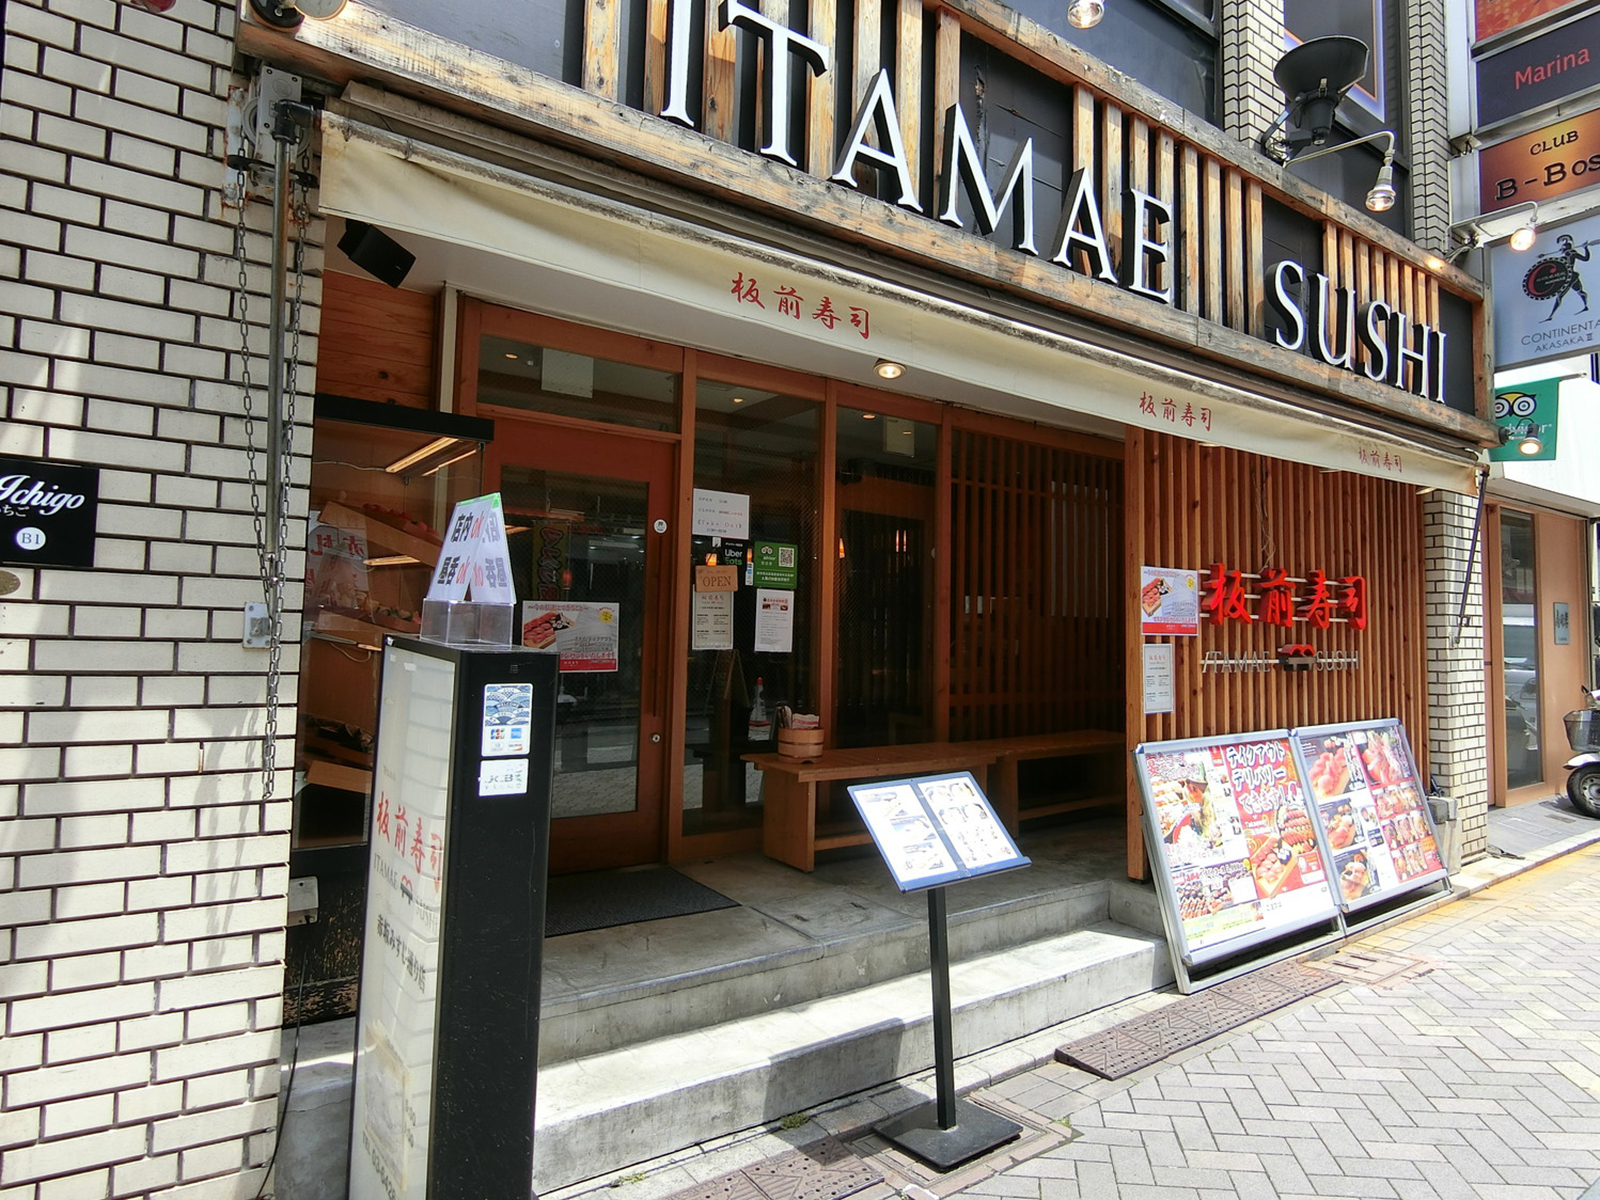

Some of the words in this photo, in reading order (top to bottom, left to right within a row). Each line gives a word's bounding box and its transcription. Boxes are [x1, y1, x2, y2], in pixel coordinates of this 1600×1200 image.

[1514, 48, 1590, 89] Marina
[1530, 130, 1579, 155] CLUB
[660, 0, 1172, 302] ITAMAE
[1270, 260, 1447, 403] SUSHI
[731, 271, 871, 338] 板前寿司
[1534, 335, 1584, 353] AKASAKA
[1139, 391, 1212, 431] 板前寿司
[1358, 448, 1403, 473] 板前寿司
[0, 475, 85, 516] Ichigo
[21, 533, 40, 545] B1
[724, 548, 743, 558] Uber
[725, 557, 743, 566] Eats
[702, 576, 732, 588] OPEN
[1201, 562, 1367, 630] 板前寿司
[1202, 650, 1271, 674] ITAMAE
[1316, 650, 1359, 672] SUSHI
[377, 791, 442, 893] 板前寿司
[374, 853, 398, 890] ITAMAE
